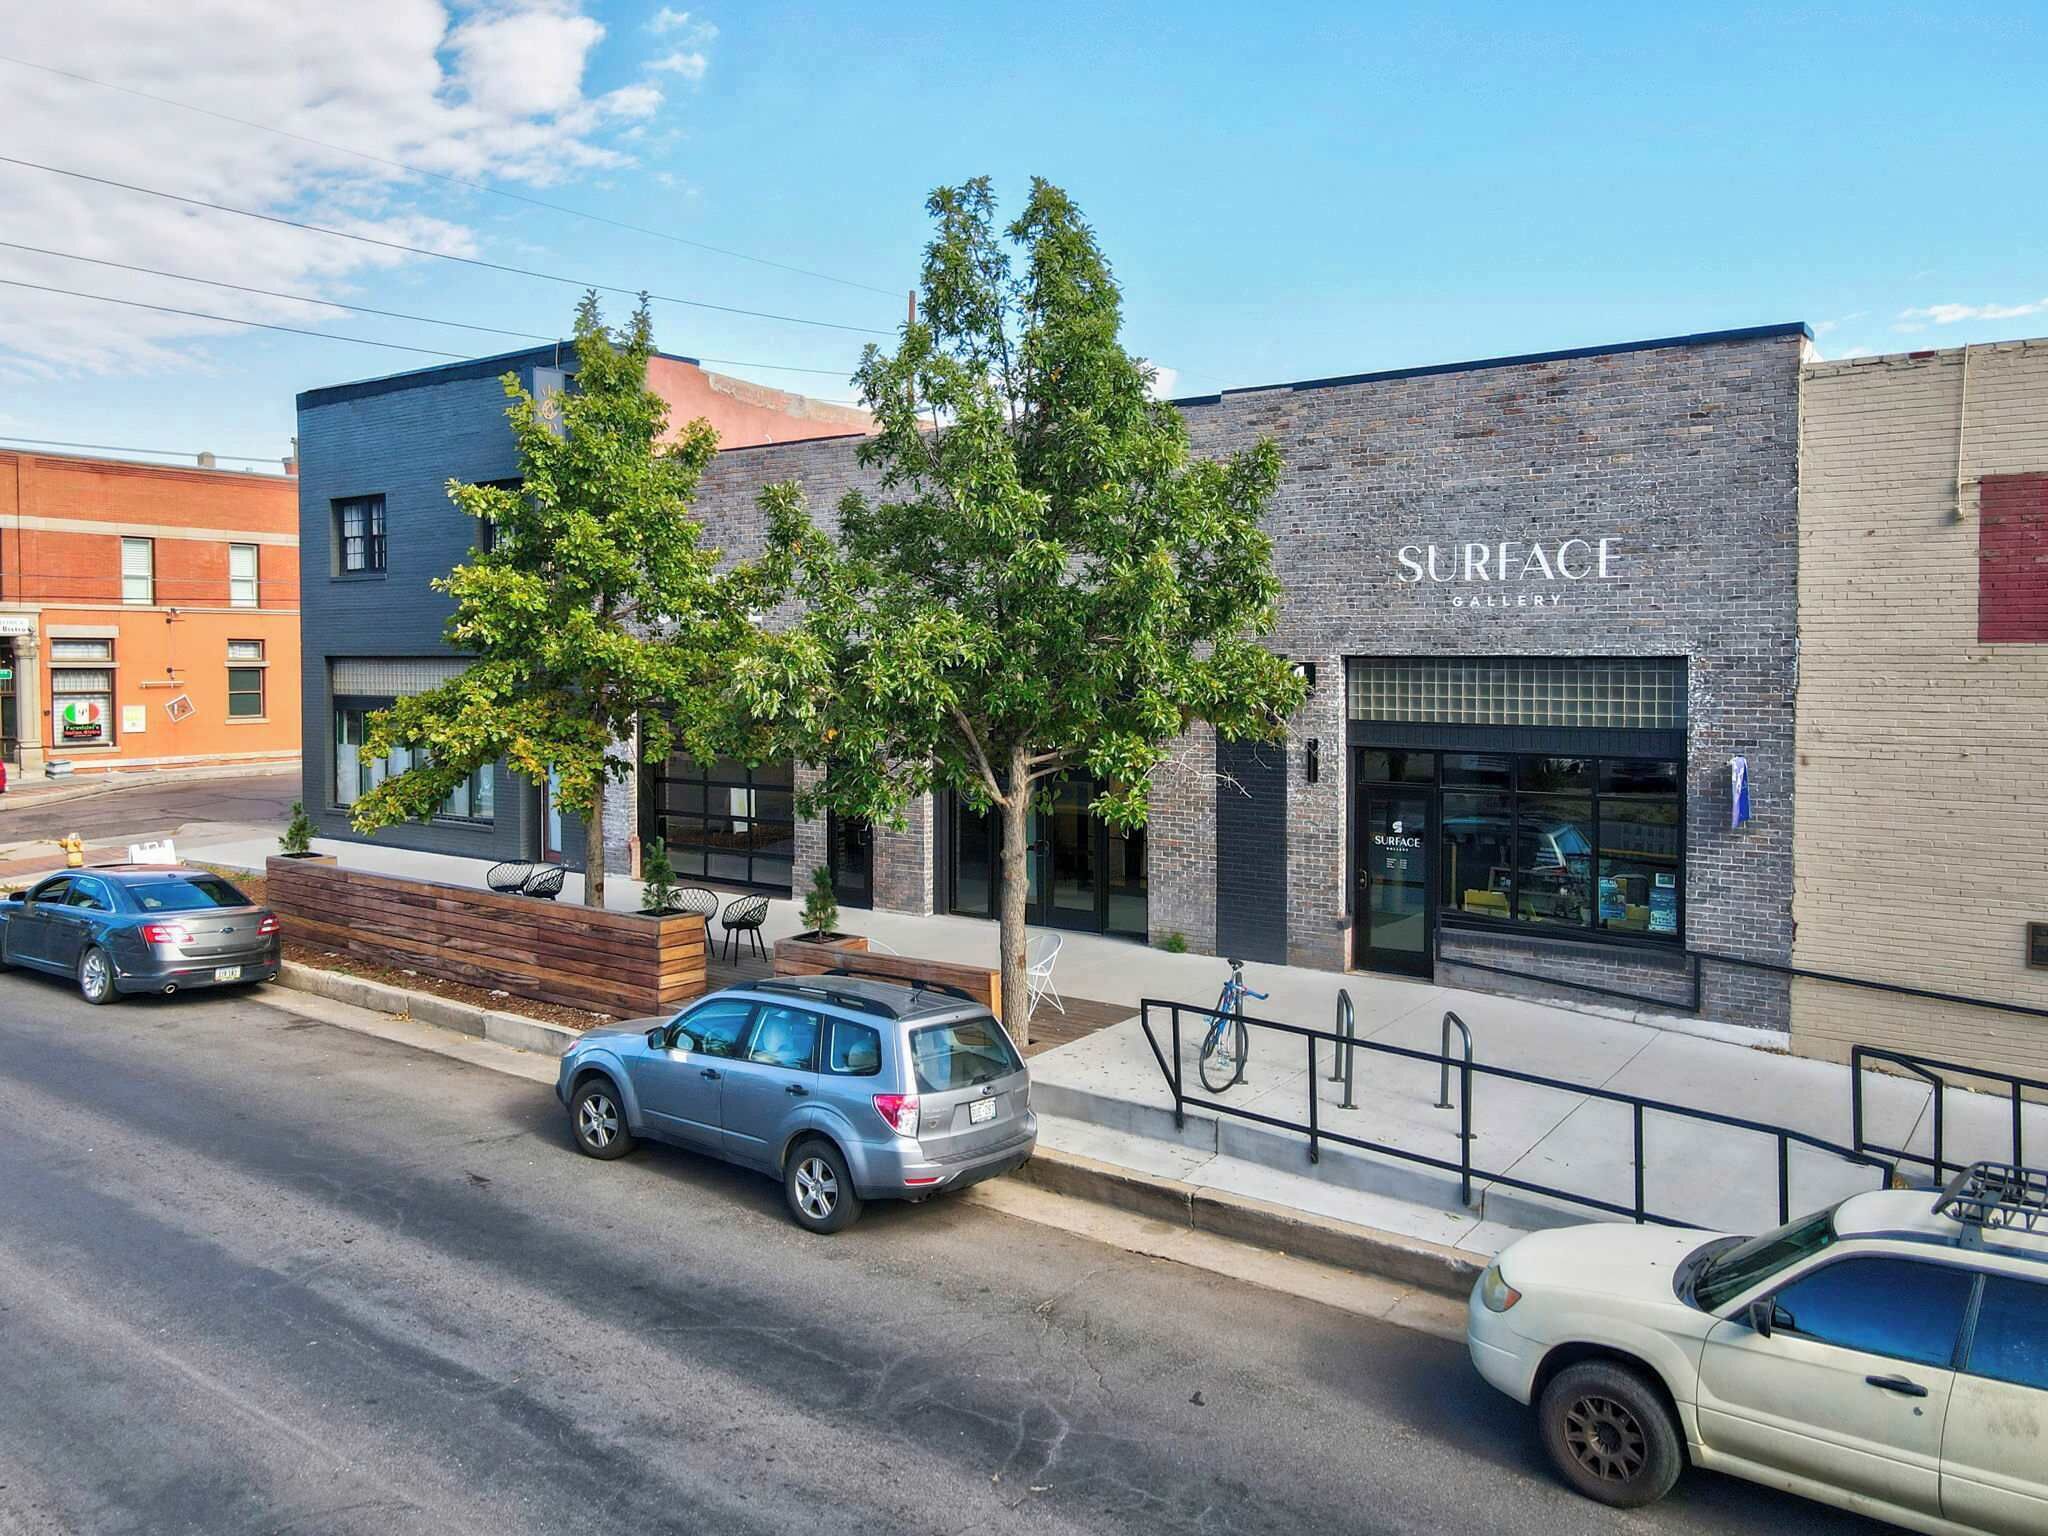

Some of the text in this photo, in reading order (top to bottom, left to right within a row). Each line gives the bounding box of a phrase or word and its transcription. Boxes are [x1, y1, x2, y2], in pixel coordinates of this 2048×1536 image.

[1398, 537, 1624, 583] SURFACE
[1452, 594, 1561, 607] GALLERY
[1375, 835, 1421, 848] SURFACE
